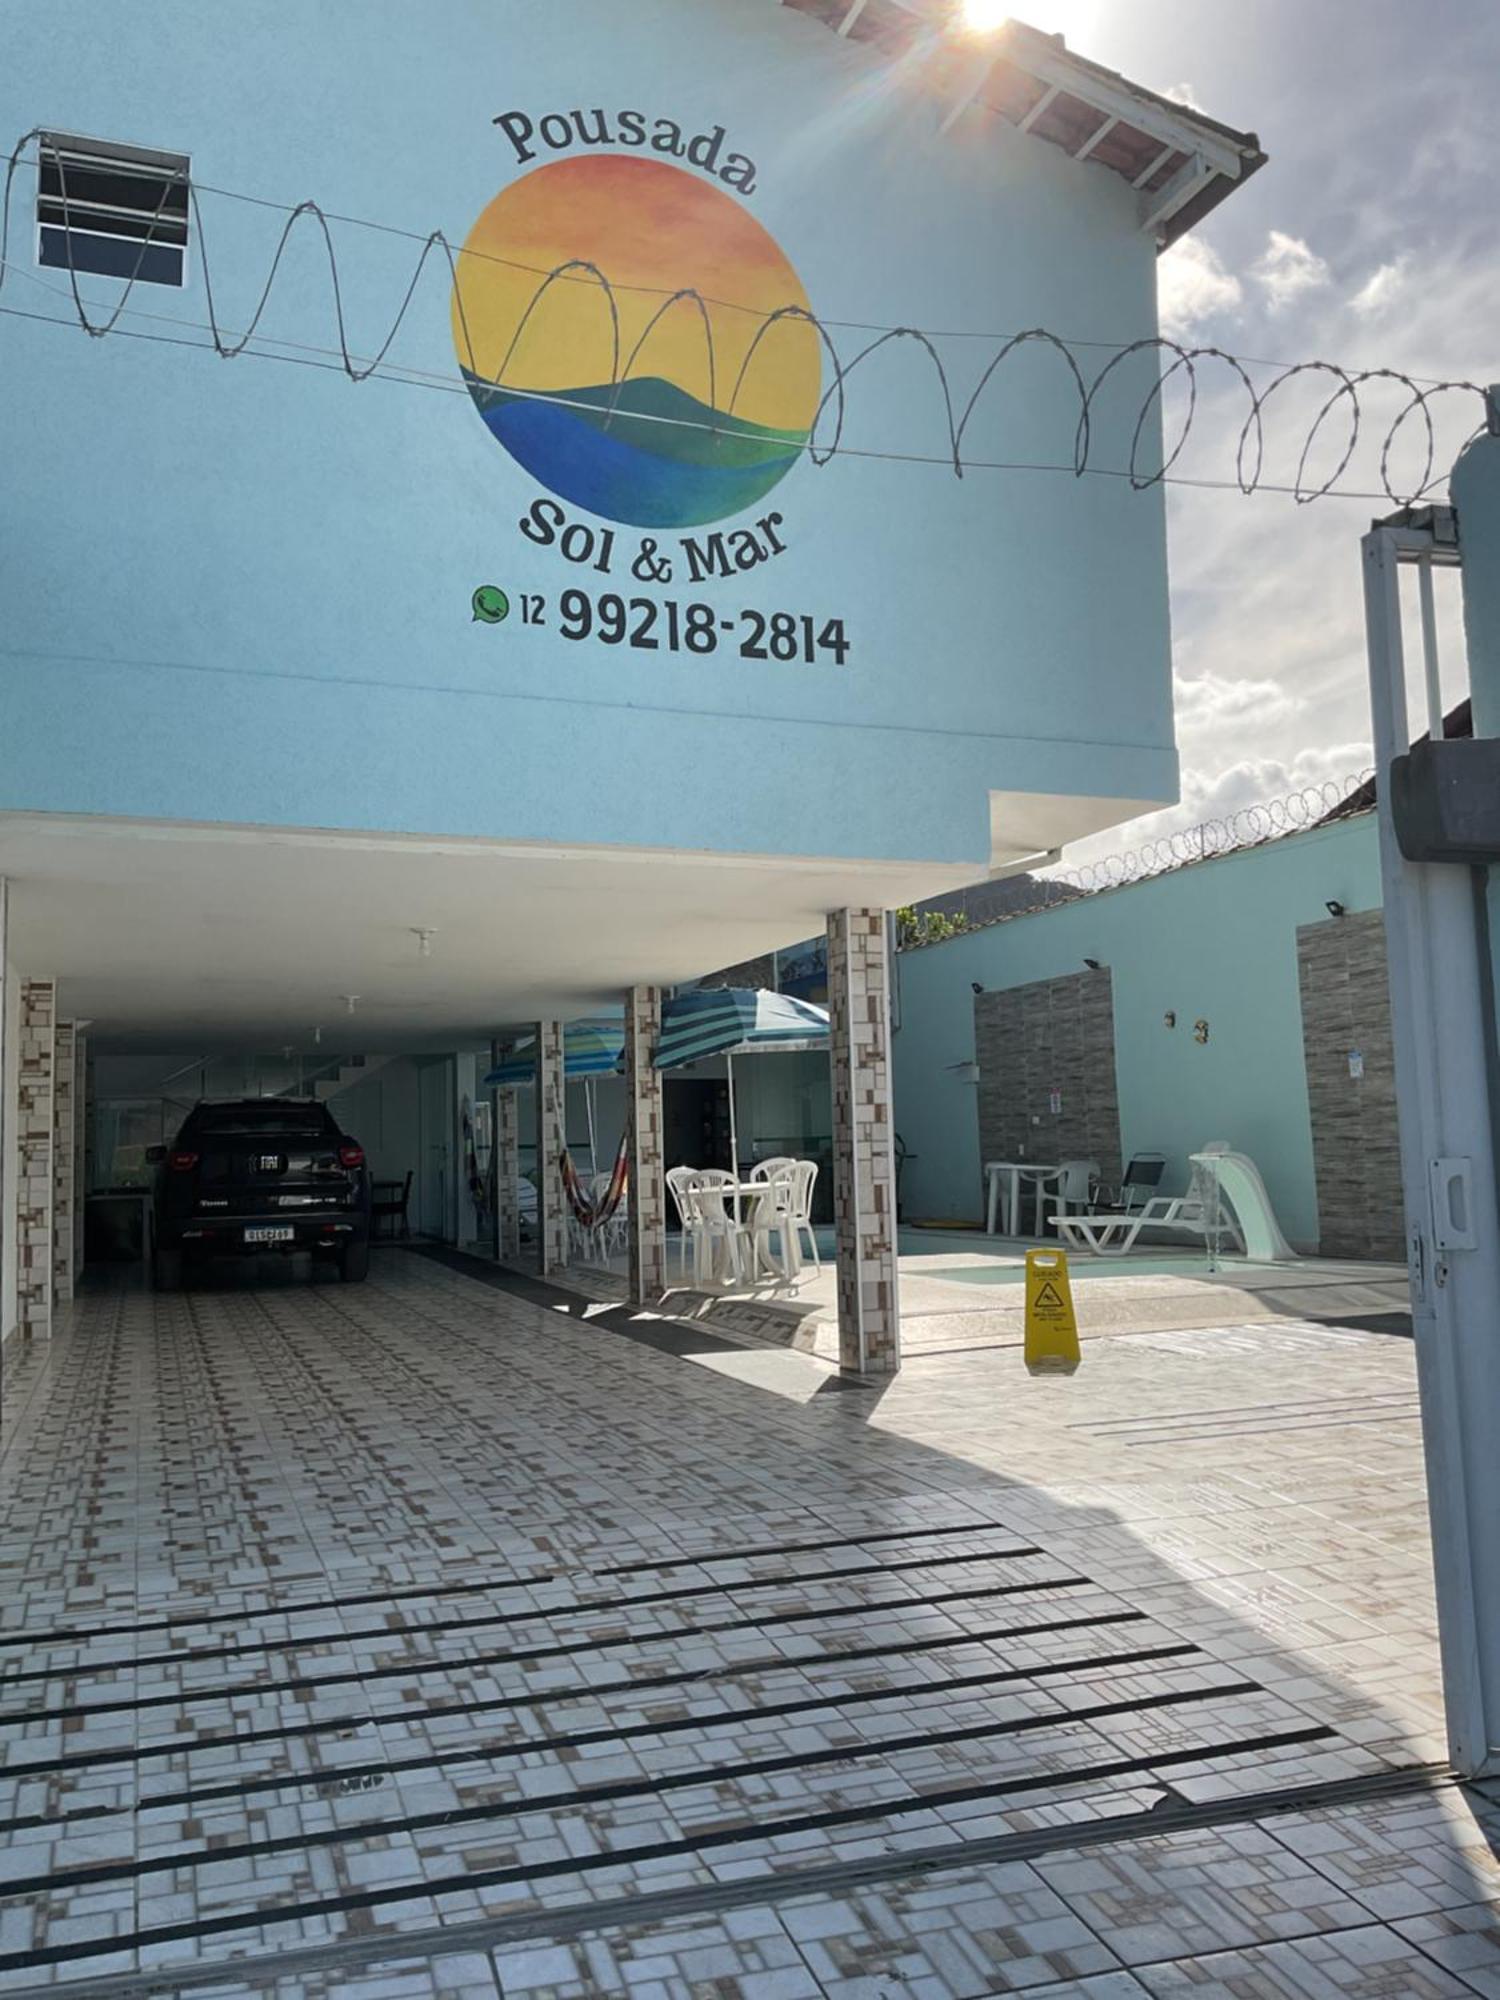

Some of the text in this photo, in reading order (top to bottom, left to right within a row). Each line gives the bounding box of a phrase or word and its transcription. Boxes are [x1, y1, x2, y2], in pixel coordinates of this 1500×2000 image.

[492, 109, 757, 195] Pousada
[519, 498, 788, 584] Sol & Mar
[519, 589, 851, 667] 12 99218-2814
